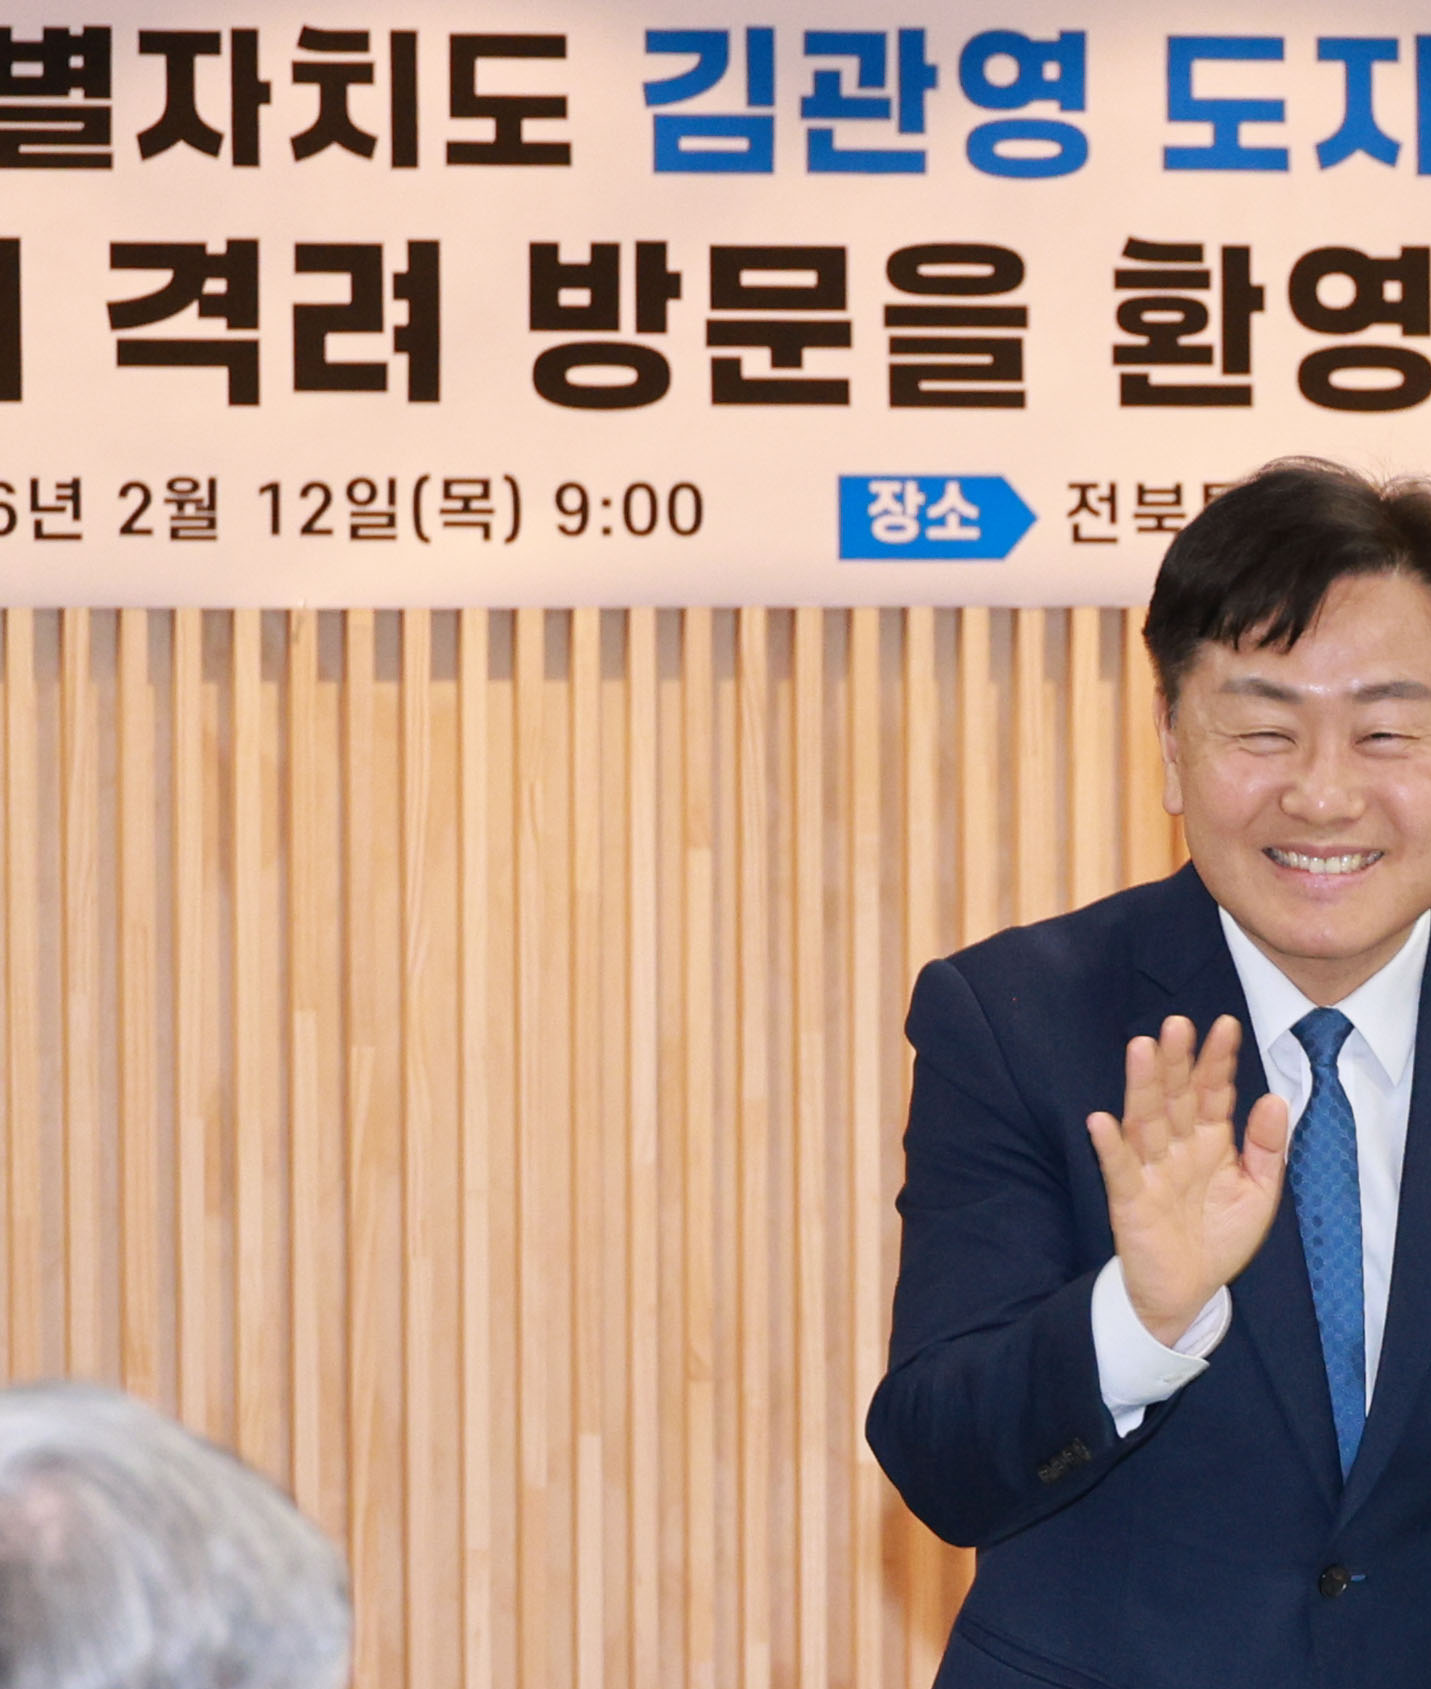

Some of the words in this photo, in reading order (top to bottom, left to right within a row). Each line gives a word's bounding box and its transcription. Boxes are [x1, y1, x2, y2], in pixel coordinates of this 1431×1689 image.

[642, 26, 1089, 180] 김관영
[106, 238, 441, 407] 격려
[528, 240, 1029, 411] 방문을
[117, 476, 219, 542] 2월
[258, 474, 522, 544] 12일(목)
[554, 481, 703, 537] 9:00
[868, 477, 982, 539] 장소
